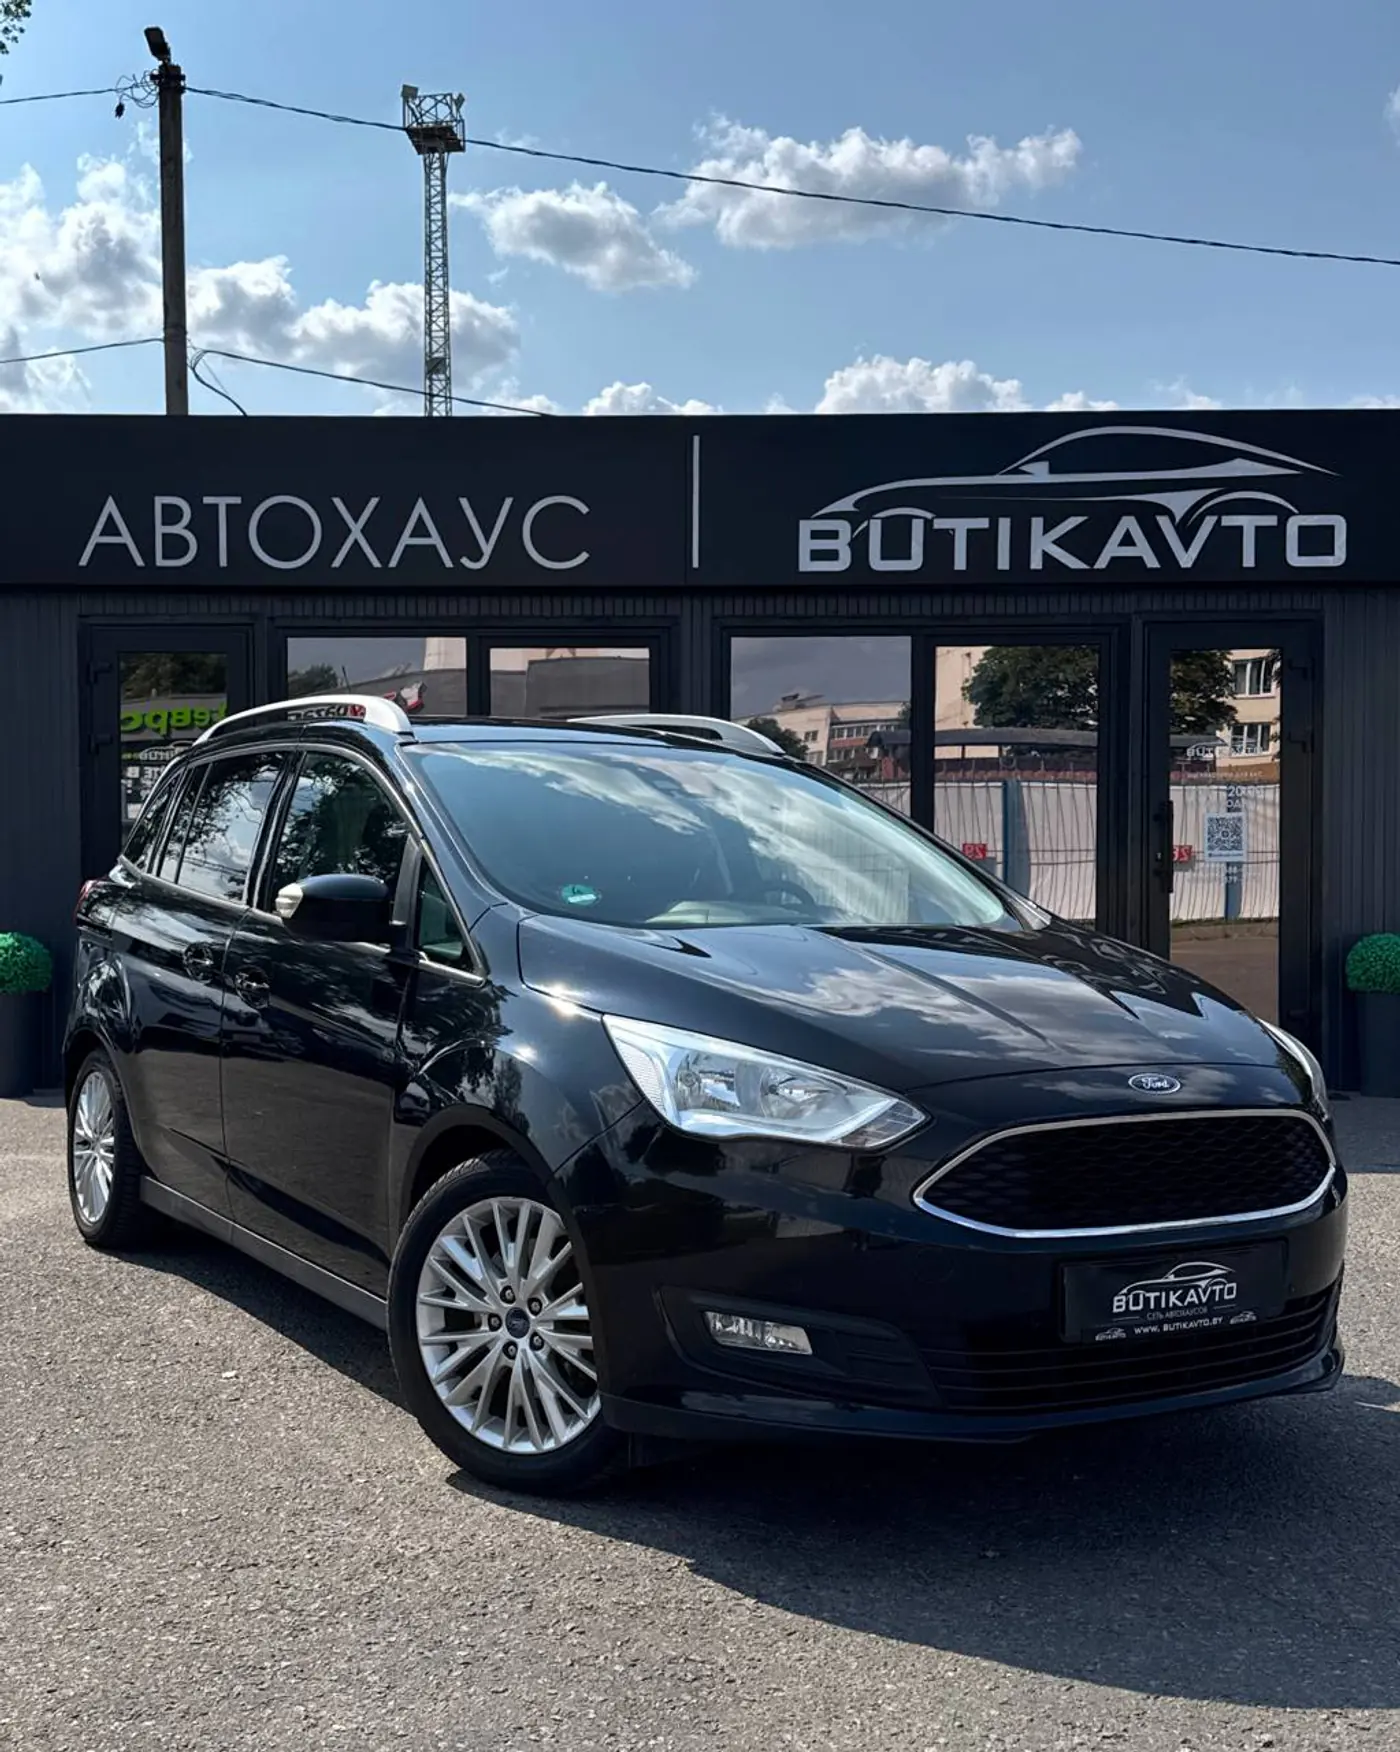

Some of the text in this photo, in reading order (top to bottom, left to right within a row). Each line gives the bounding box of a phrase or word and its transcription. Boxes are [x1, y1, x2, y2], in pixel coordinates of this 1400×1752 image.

[78, 494, 591, 570] АВТОХАУС
[798, 513, 1347, 573] BUTIKAVTO
[1141, 1077, 1170, 1090] Ford
[1112, 1282, 1237, 1313] BUTIKAVTO
